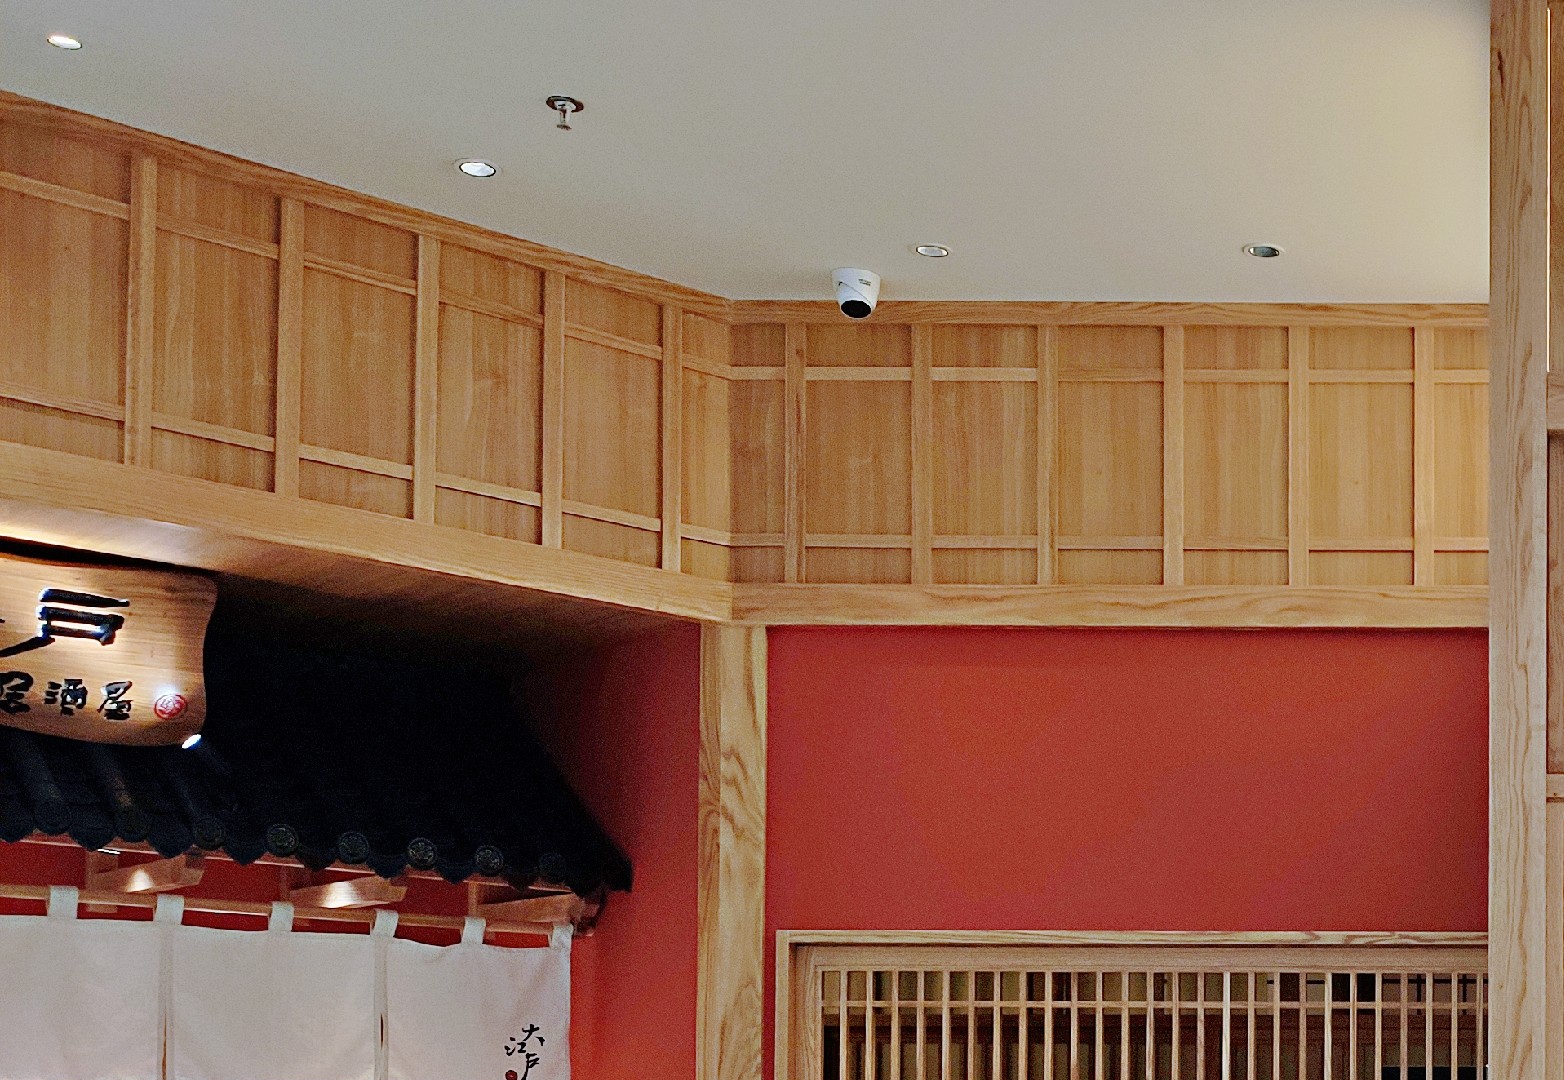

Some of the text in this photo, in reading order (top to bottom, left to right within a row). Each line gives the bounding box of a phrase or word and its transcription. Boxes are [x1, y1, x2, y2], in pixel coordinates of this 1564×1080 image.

[0, 588, 130, 657] 戸
[0, 671, 133, 720] 居酒屋
